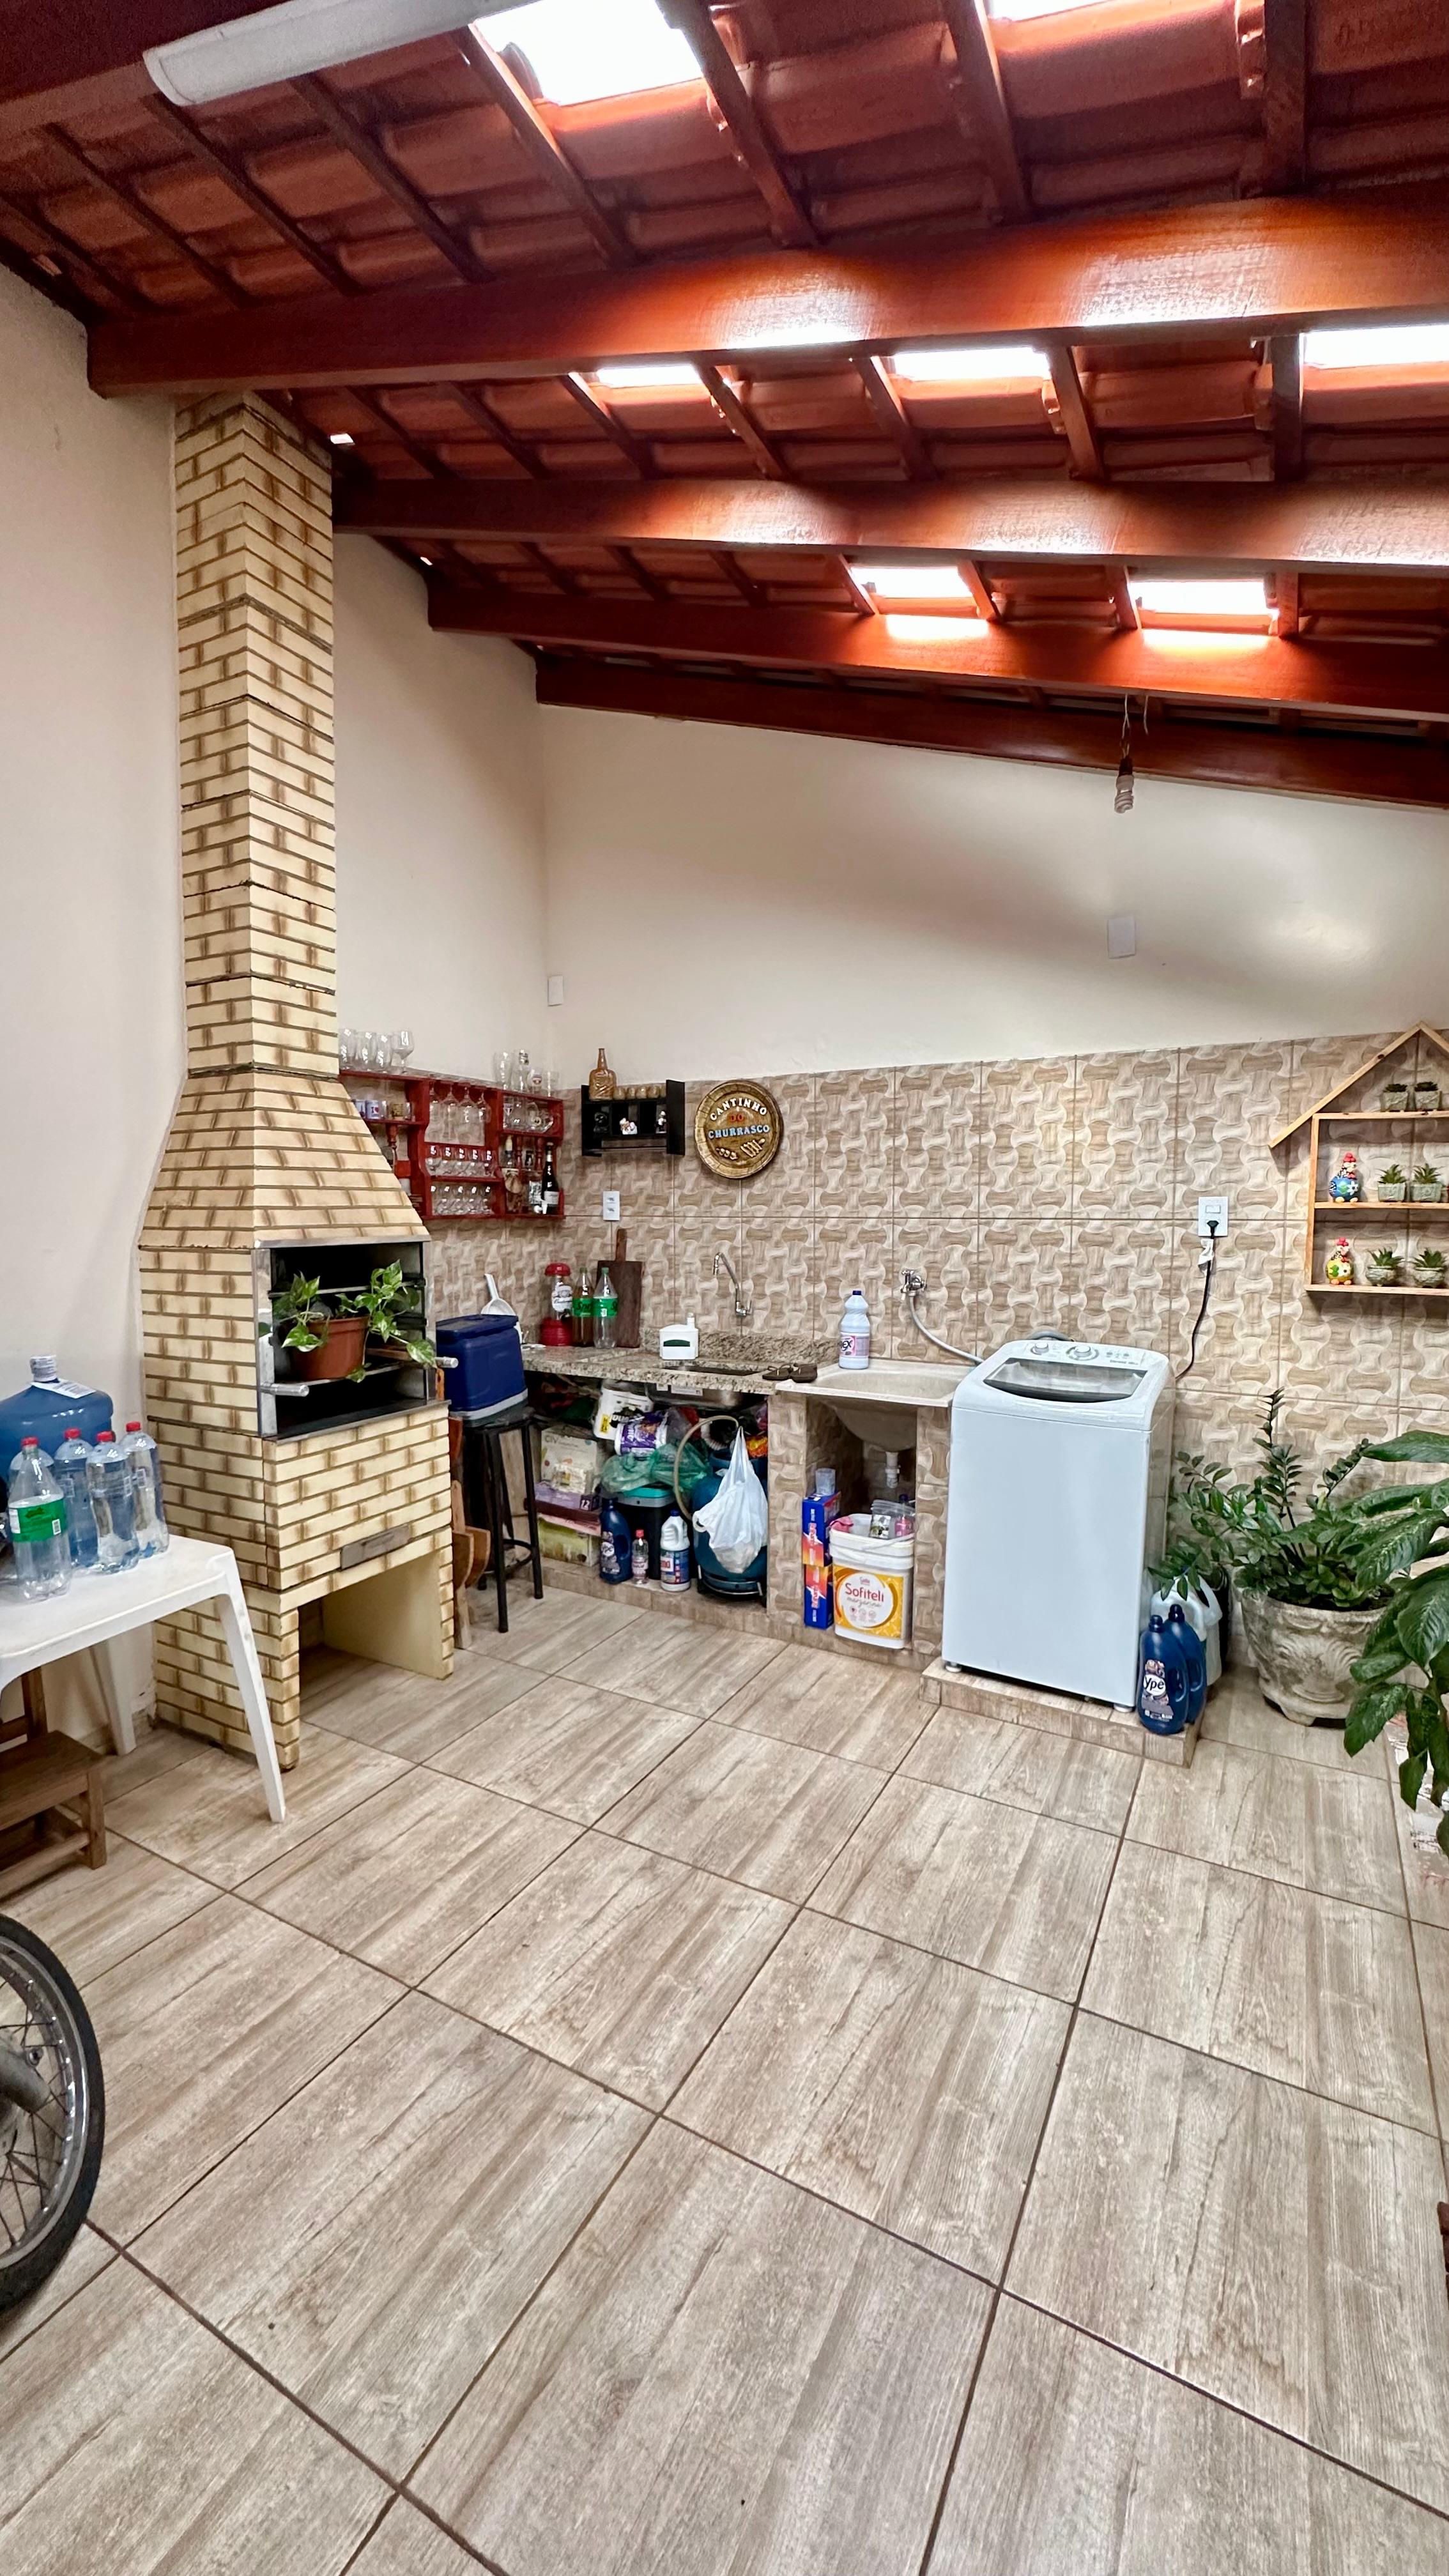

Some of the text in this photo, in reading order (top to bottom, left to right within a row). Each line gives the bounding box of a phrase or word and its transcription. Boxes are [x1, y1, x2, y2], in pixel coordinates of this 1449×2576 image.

[710, 1098, 768, 1121] CANTINHO
[730, 1113, 745, 1123] DO
[708, 1124, 770, 1139] CHURRASCO
[580, 1499, 591, 1509] 12
[845, 1583, 884, 1602] Sofiteli
